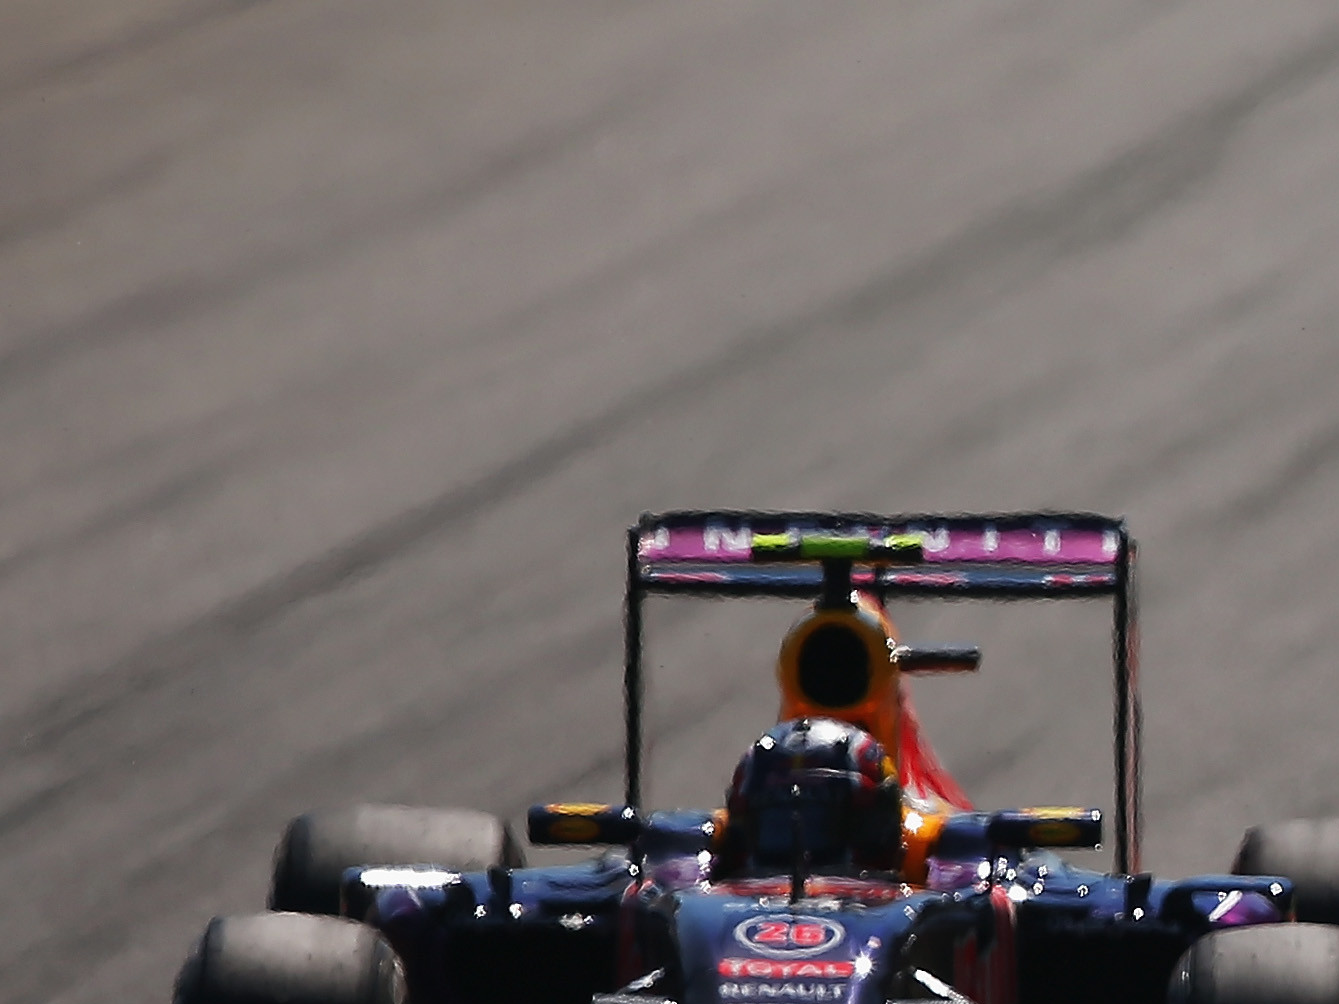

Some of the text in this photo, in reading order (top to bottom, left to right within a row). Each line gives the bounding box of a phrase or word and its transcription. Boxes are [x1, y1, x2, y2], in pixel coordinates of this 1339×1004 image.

[753, 920, 826, 945] 26
[724, 958, 849, 977] TOTAL
[718, 983, 847, 1000] RENAULT
